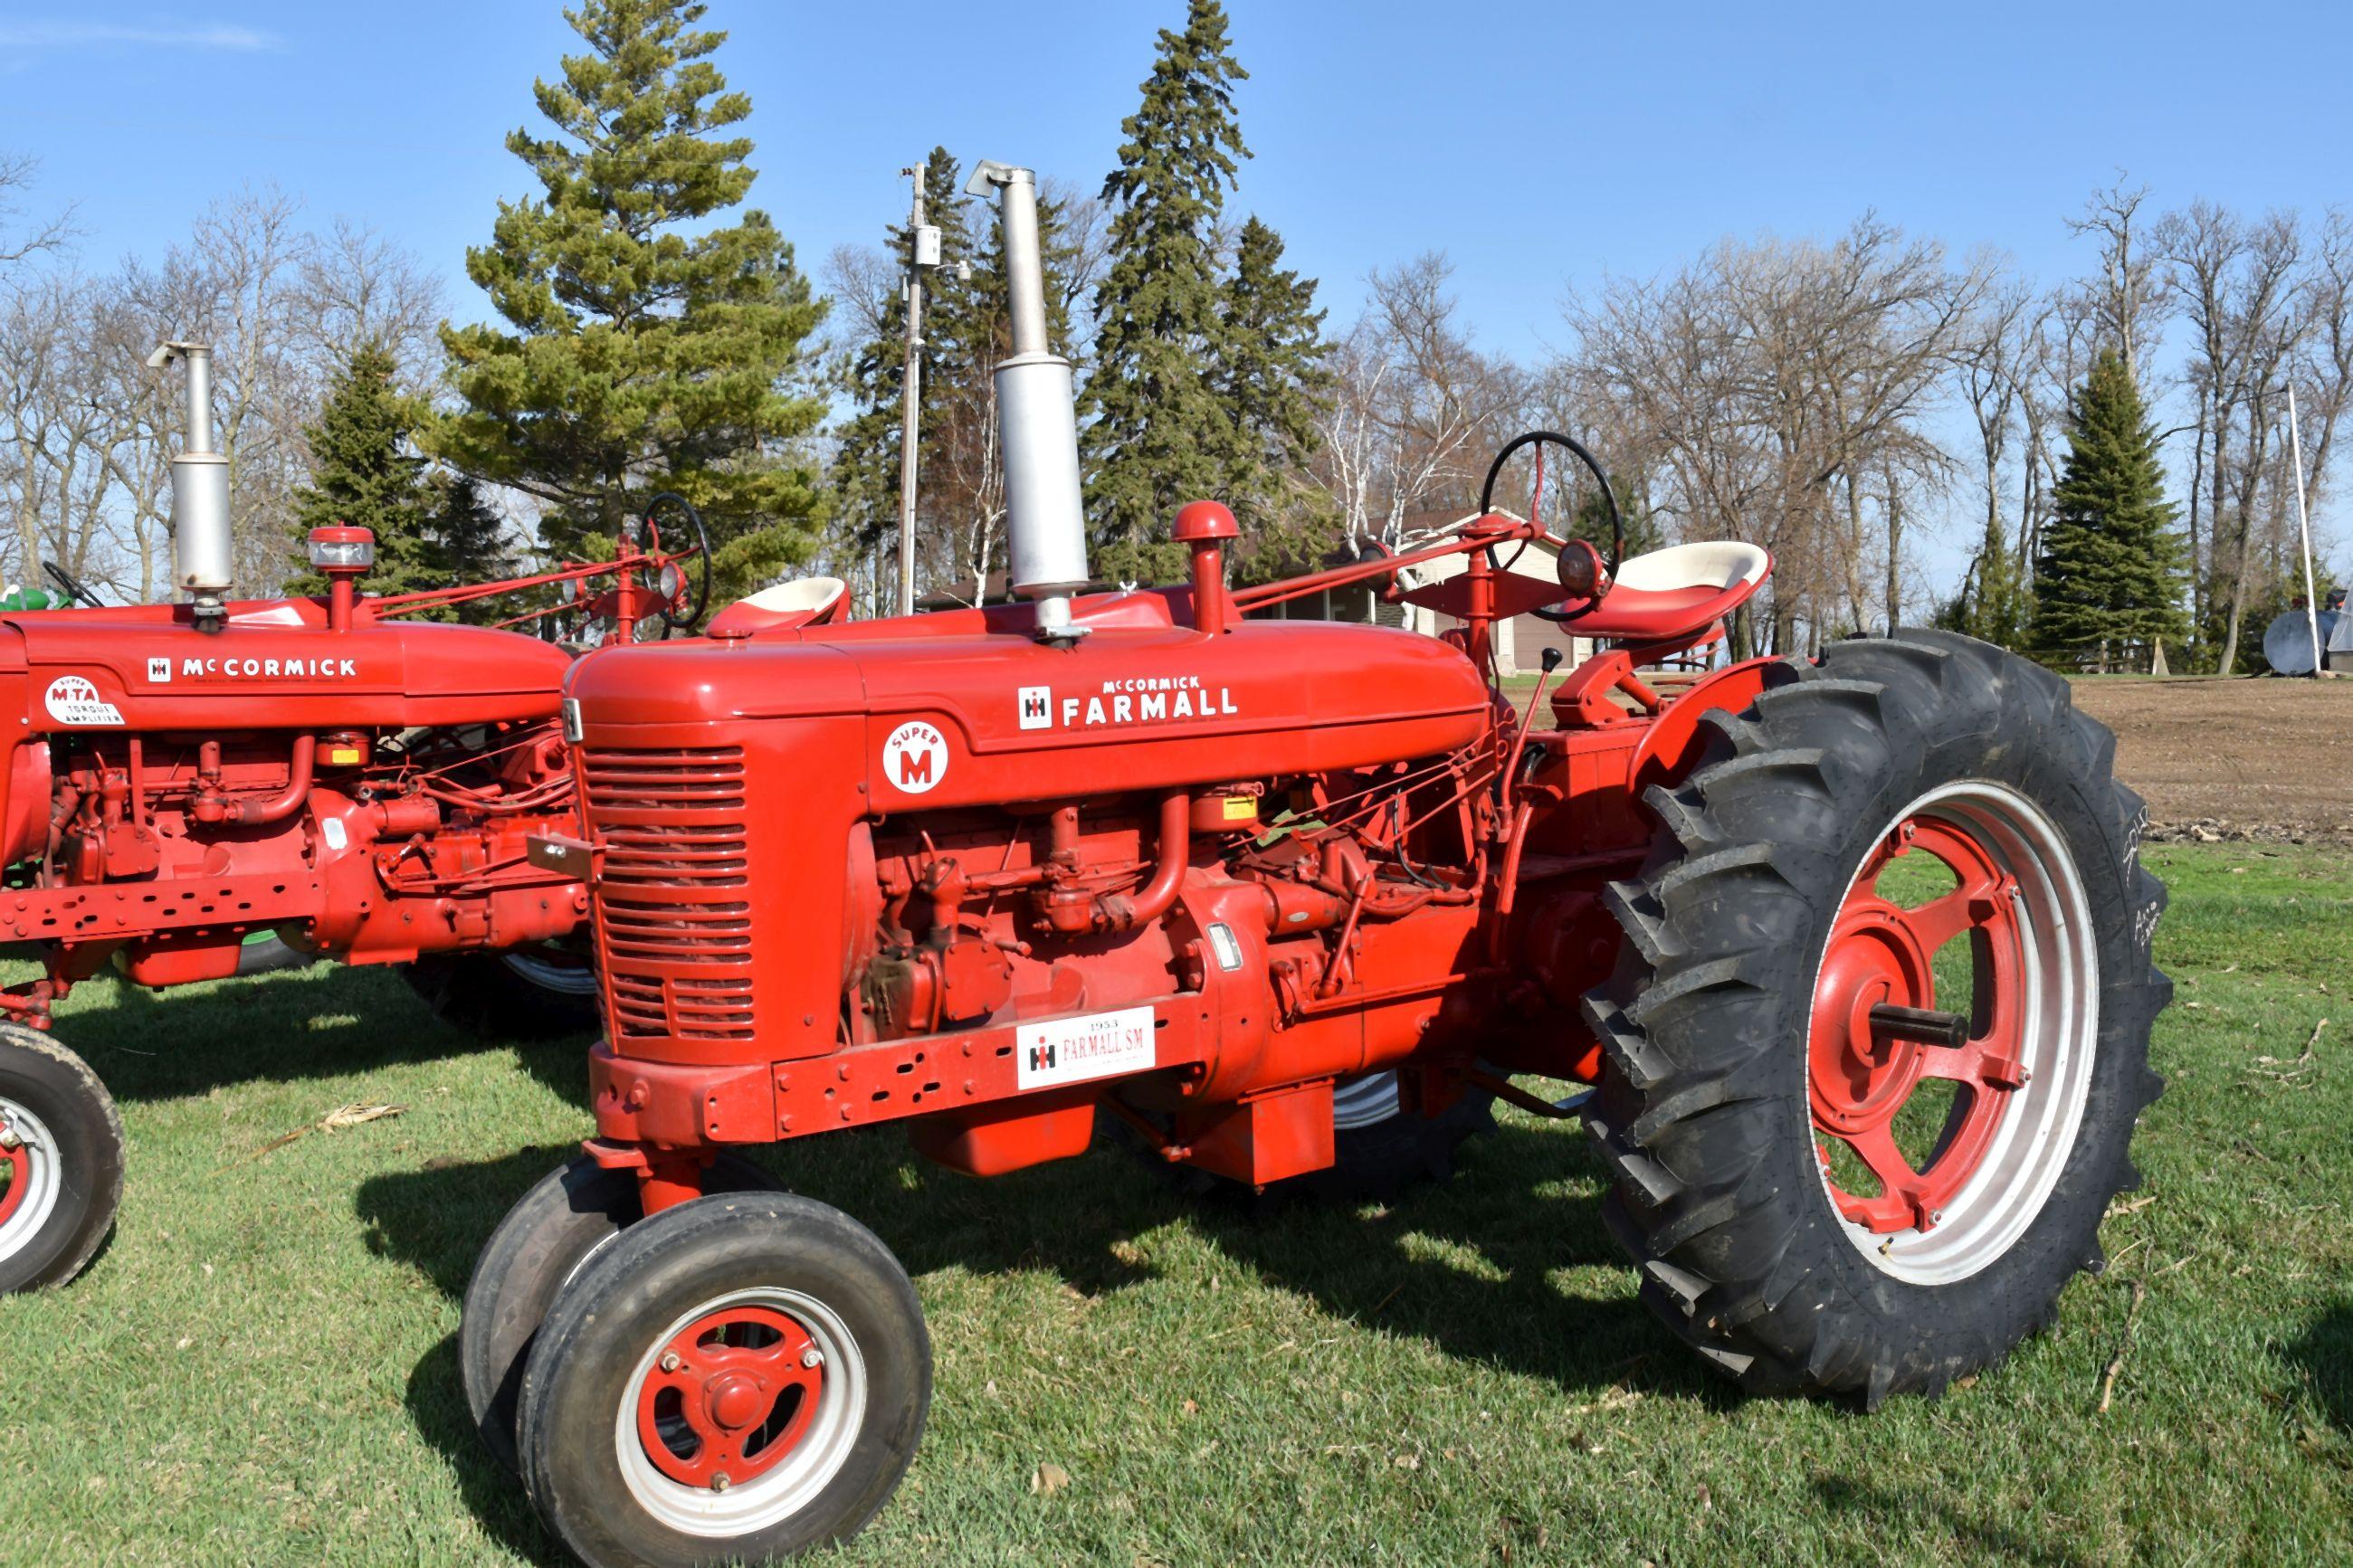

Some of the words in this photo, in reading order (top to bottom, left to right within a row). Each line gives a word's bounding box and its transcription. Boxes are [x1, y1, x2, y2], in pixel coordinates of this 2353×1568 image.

[1062, 688, 1238, 727] FARMALL
[892, 727, 938, 749] SUPER
[900, 749, 931, 784] M
[1091, 1019, 1119, 1031] 1953
[1063, 1031, 1121, 1061] FARMALL
[1125, 1028, 1143, 1050] SM
